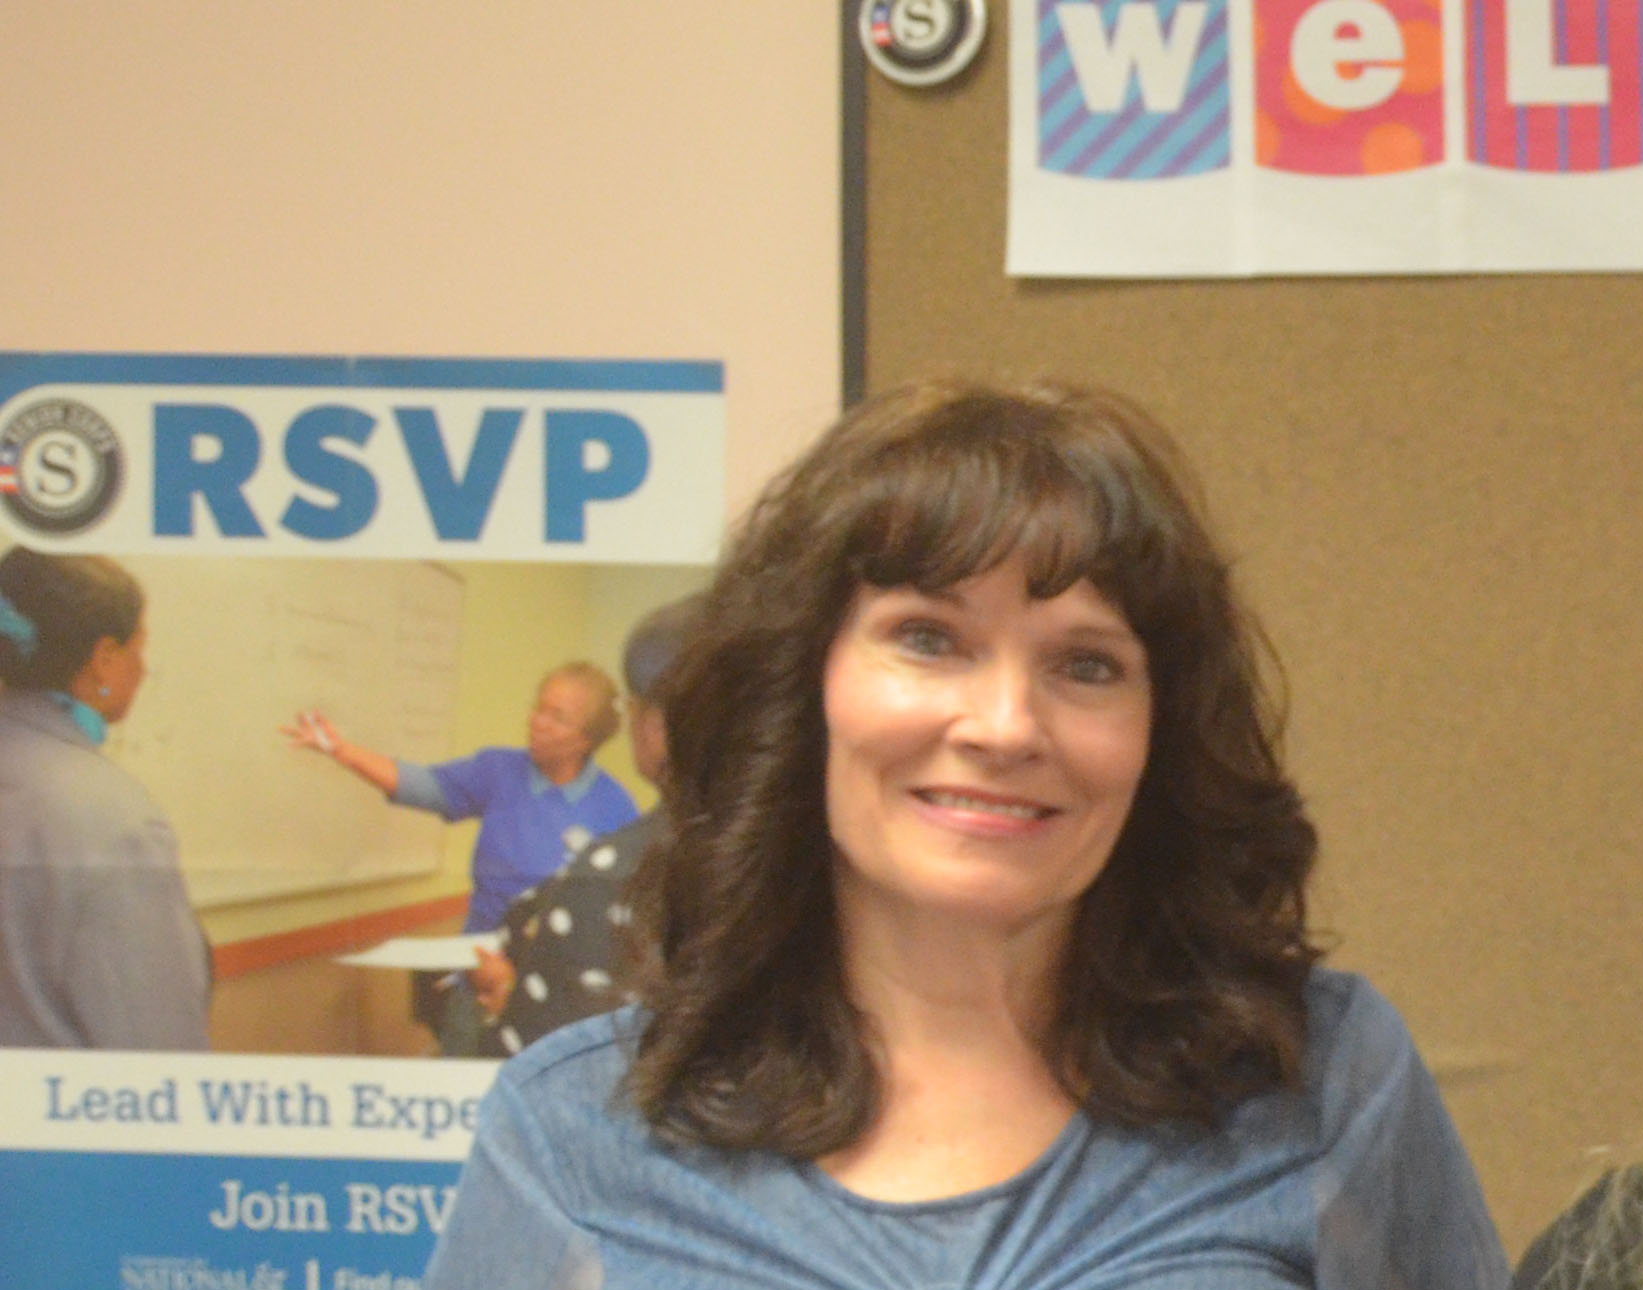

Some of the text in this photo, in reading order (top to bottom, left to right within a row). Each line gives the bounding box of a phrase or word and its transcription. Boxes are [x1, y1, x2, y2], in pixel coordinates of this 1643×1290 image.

[151, 402, 652, 544] RSVP
[44, 1076, 479, 1139] Lead With Expe
[209, 1179, 460, 1235] Join RSV
